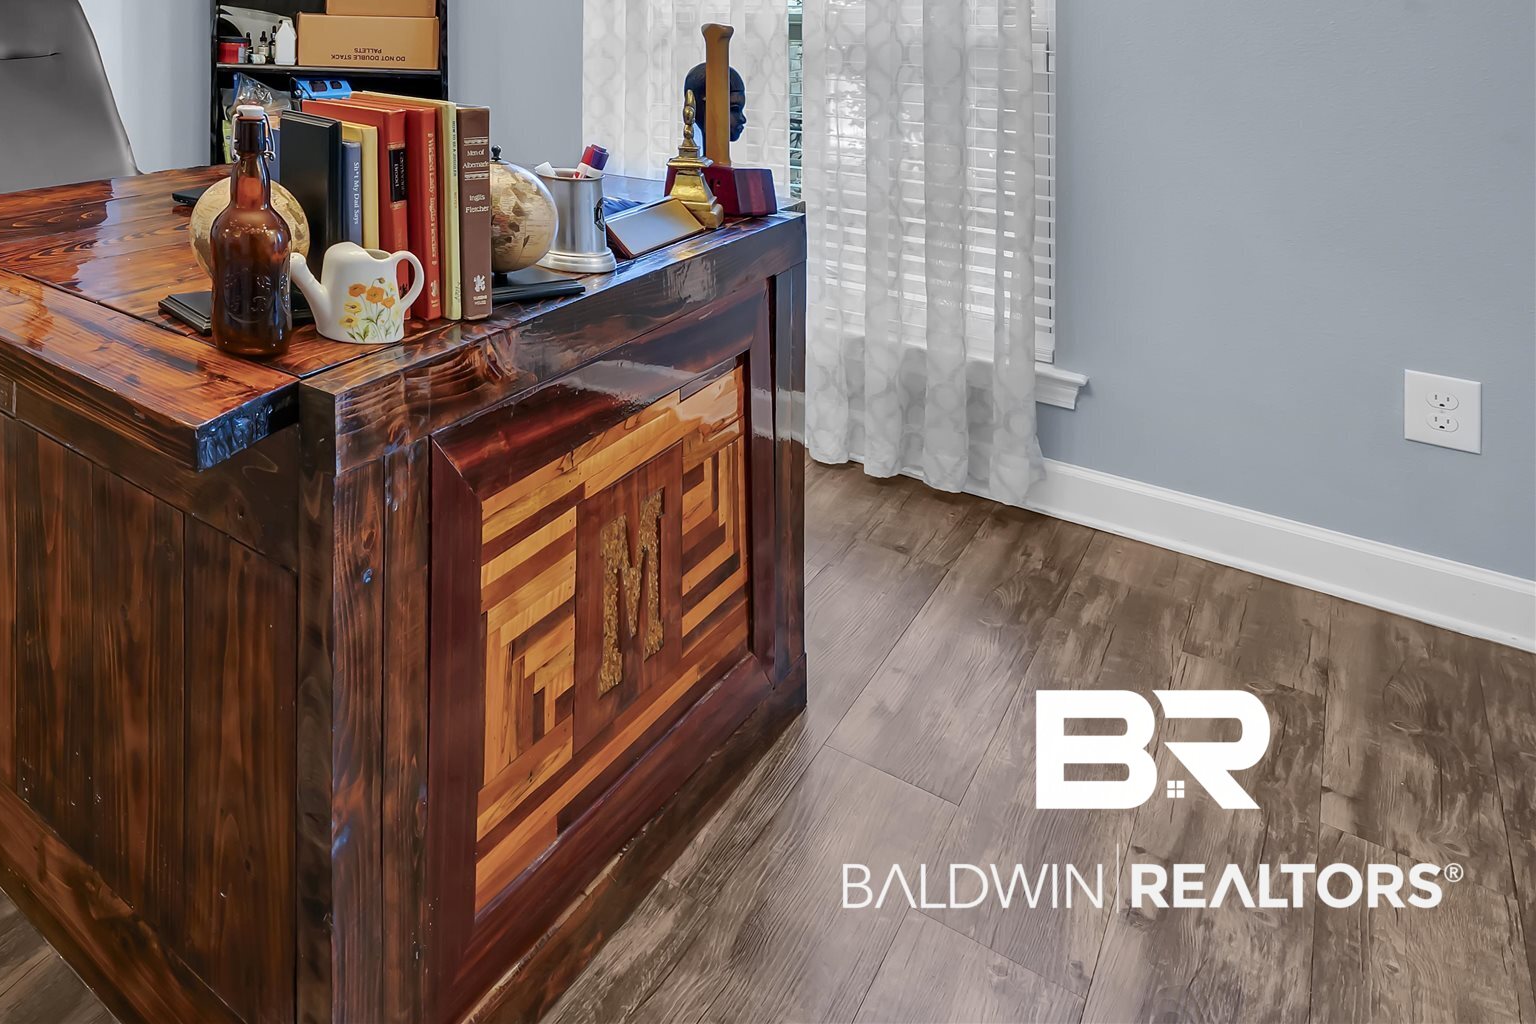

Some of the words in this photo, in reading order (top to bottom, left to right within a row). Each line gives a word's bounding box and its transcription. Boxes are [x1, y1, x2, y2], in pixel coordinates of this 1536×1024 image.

[352, 180, 360, 191] My
[469, 194, 486, 203] Inglis
[465, 205, 490, 213] Fletcher
[598, 486, 665, 699] M
